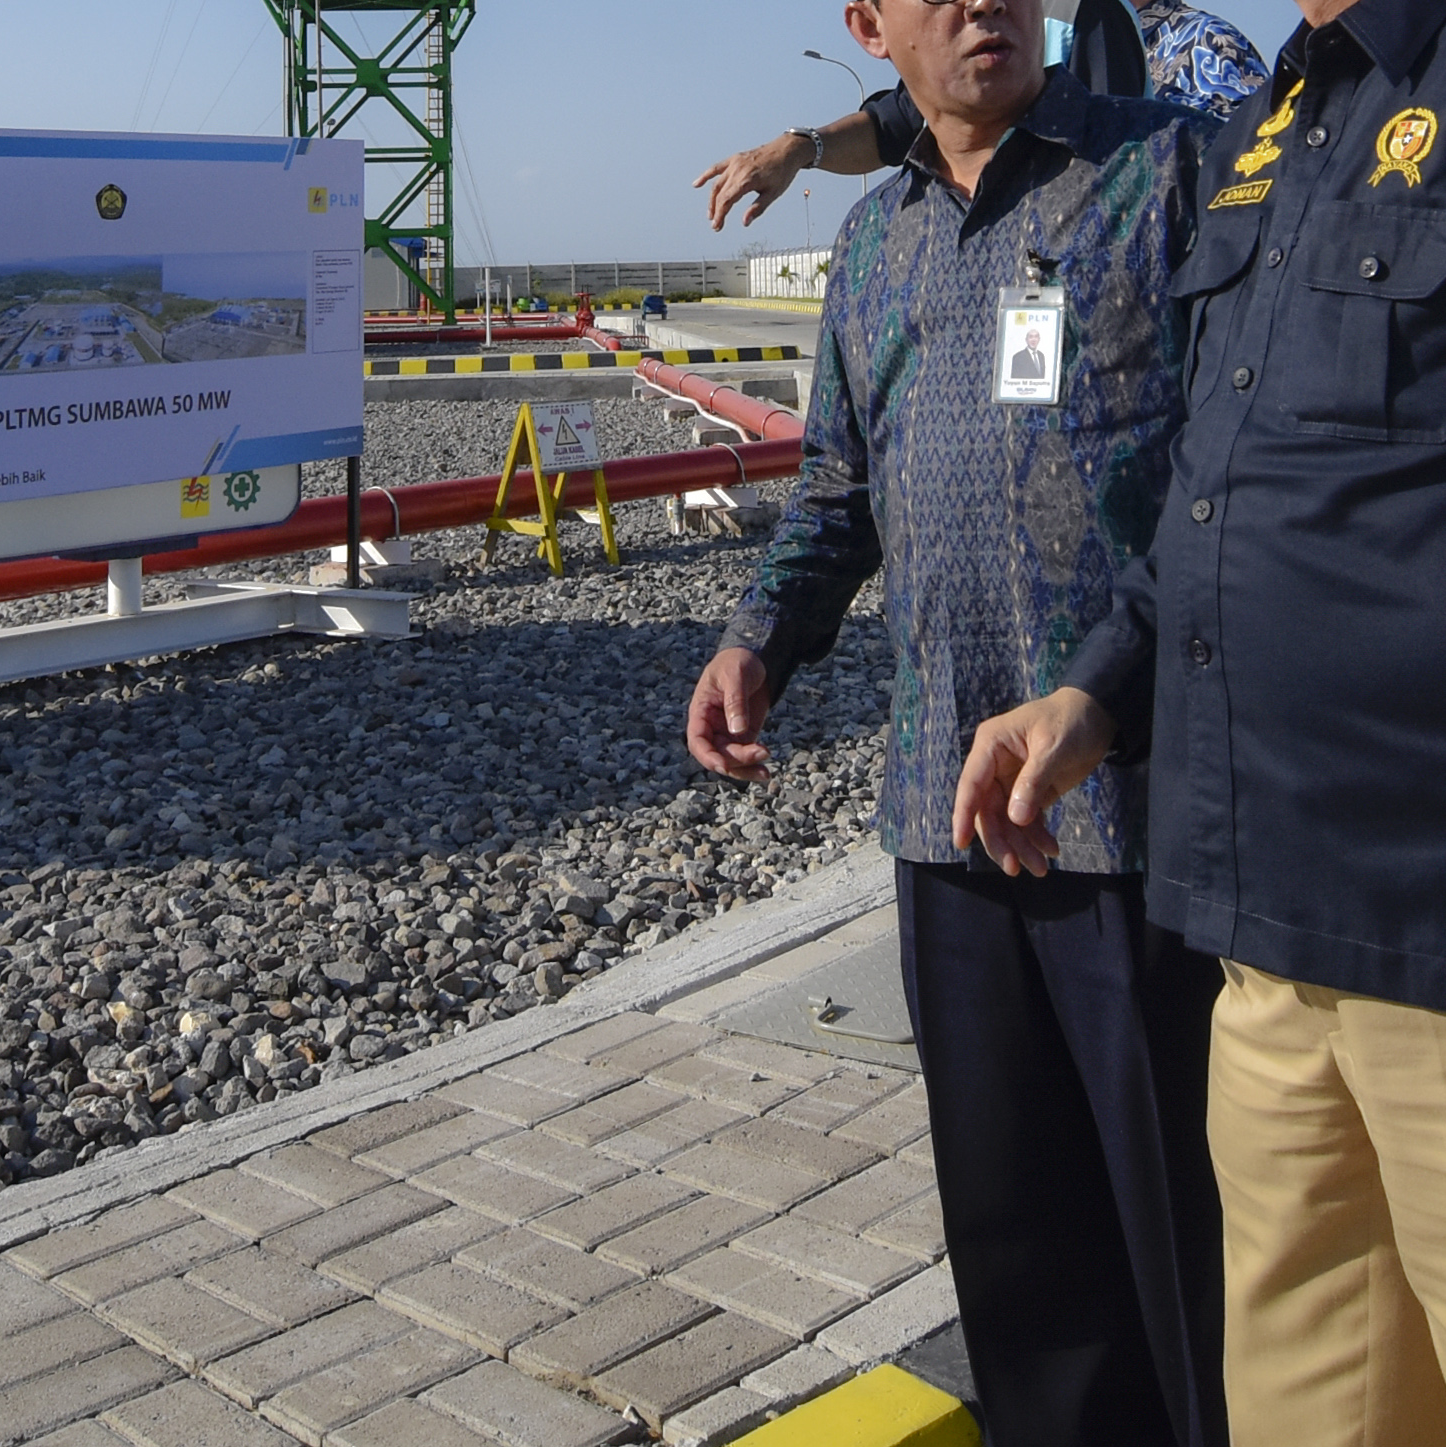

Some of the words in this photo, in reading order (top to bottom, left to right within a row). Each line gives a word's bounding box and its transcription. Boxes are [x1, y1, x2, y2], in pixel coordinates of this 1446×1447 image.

[330, 193, 359, 206] PLN
[1028, 314, 1049, 322] PLN
[67, 395, 167, 424] SUMBAWA
[172, 394, 193, 414] 50
[198, 389, 231, 411] MW
[22, 469, 46, 483] Baik
